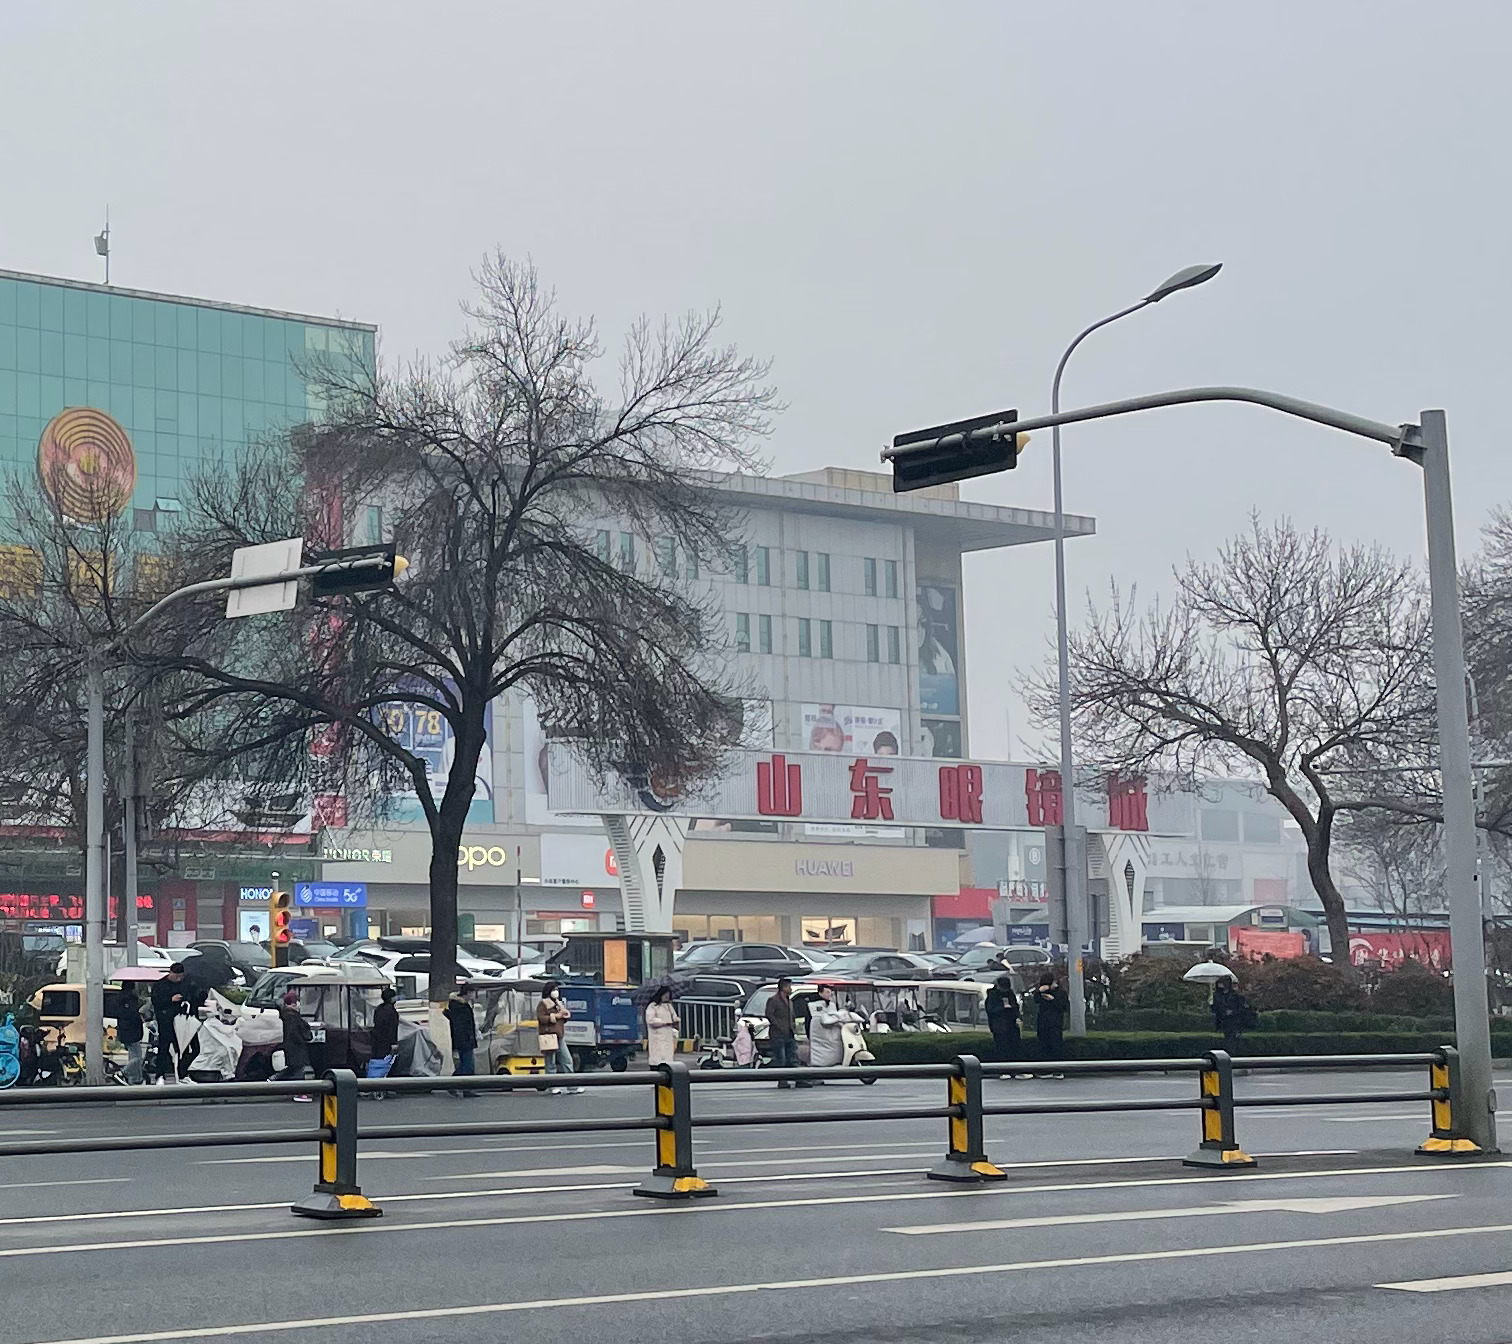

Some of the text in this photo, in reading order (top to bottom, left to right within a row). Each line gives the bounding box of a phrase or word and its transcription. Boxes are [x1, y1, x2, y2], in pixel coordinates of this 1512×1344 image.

[757, 755, 1149, 831] 山东眼镜城
[795, 859, 854, 876] HUAWEI
[343, 888, 359, 903] 5G
